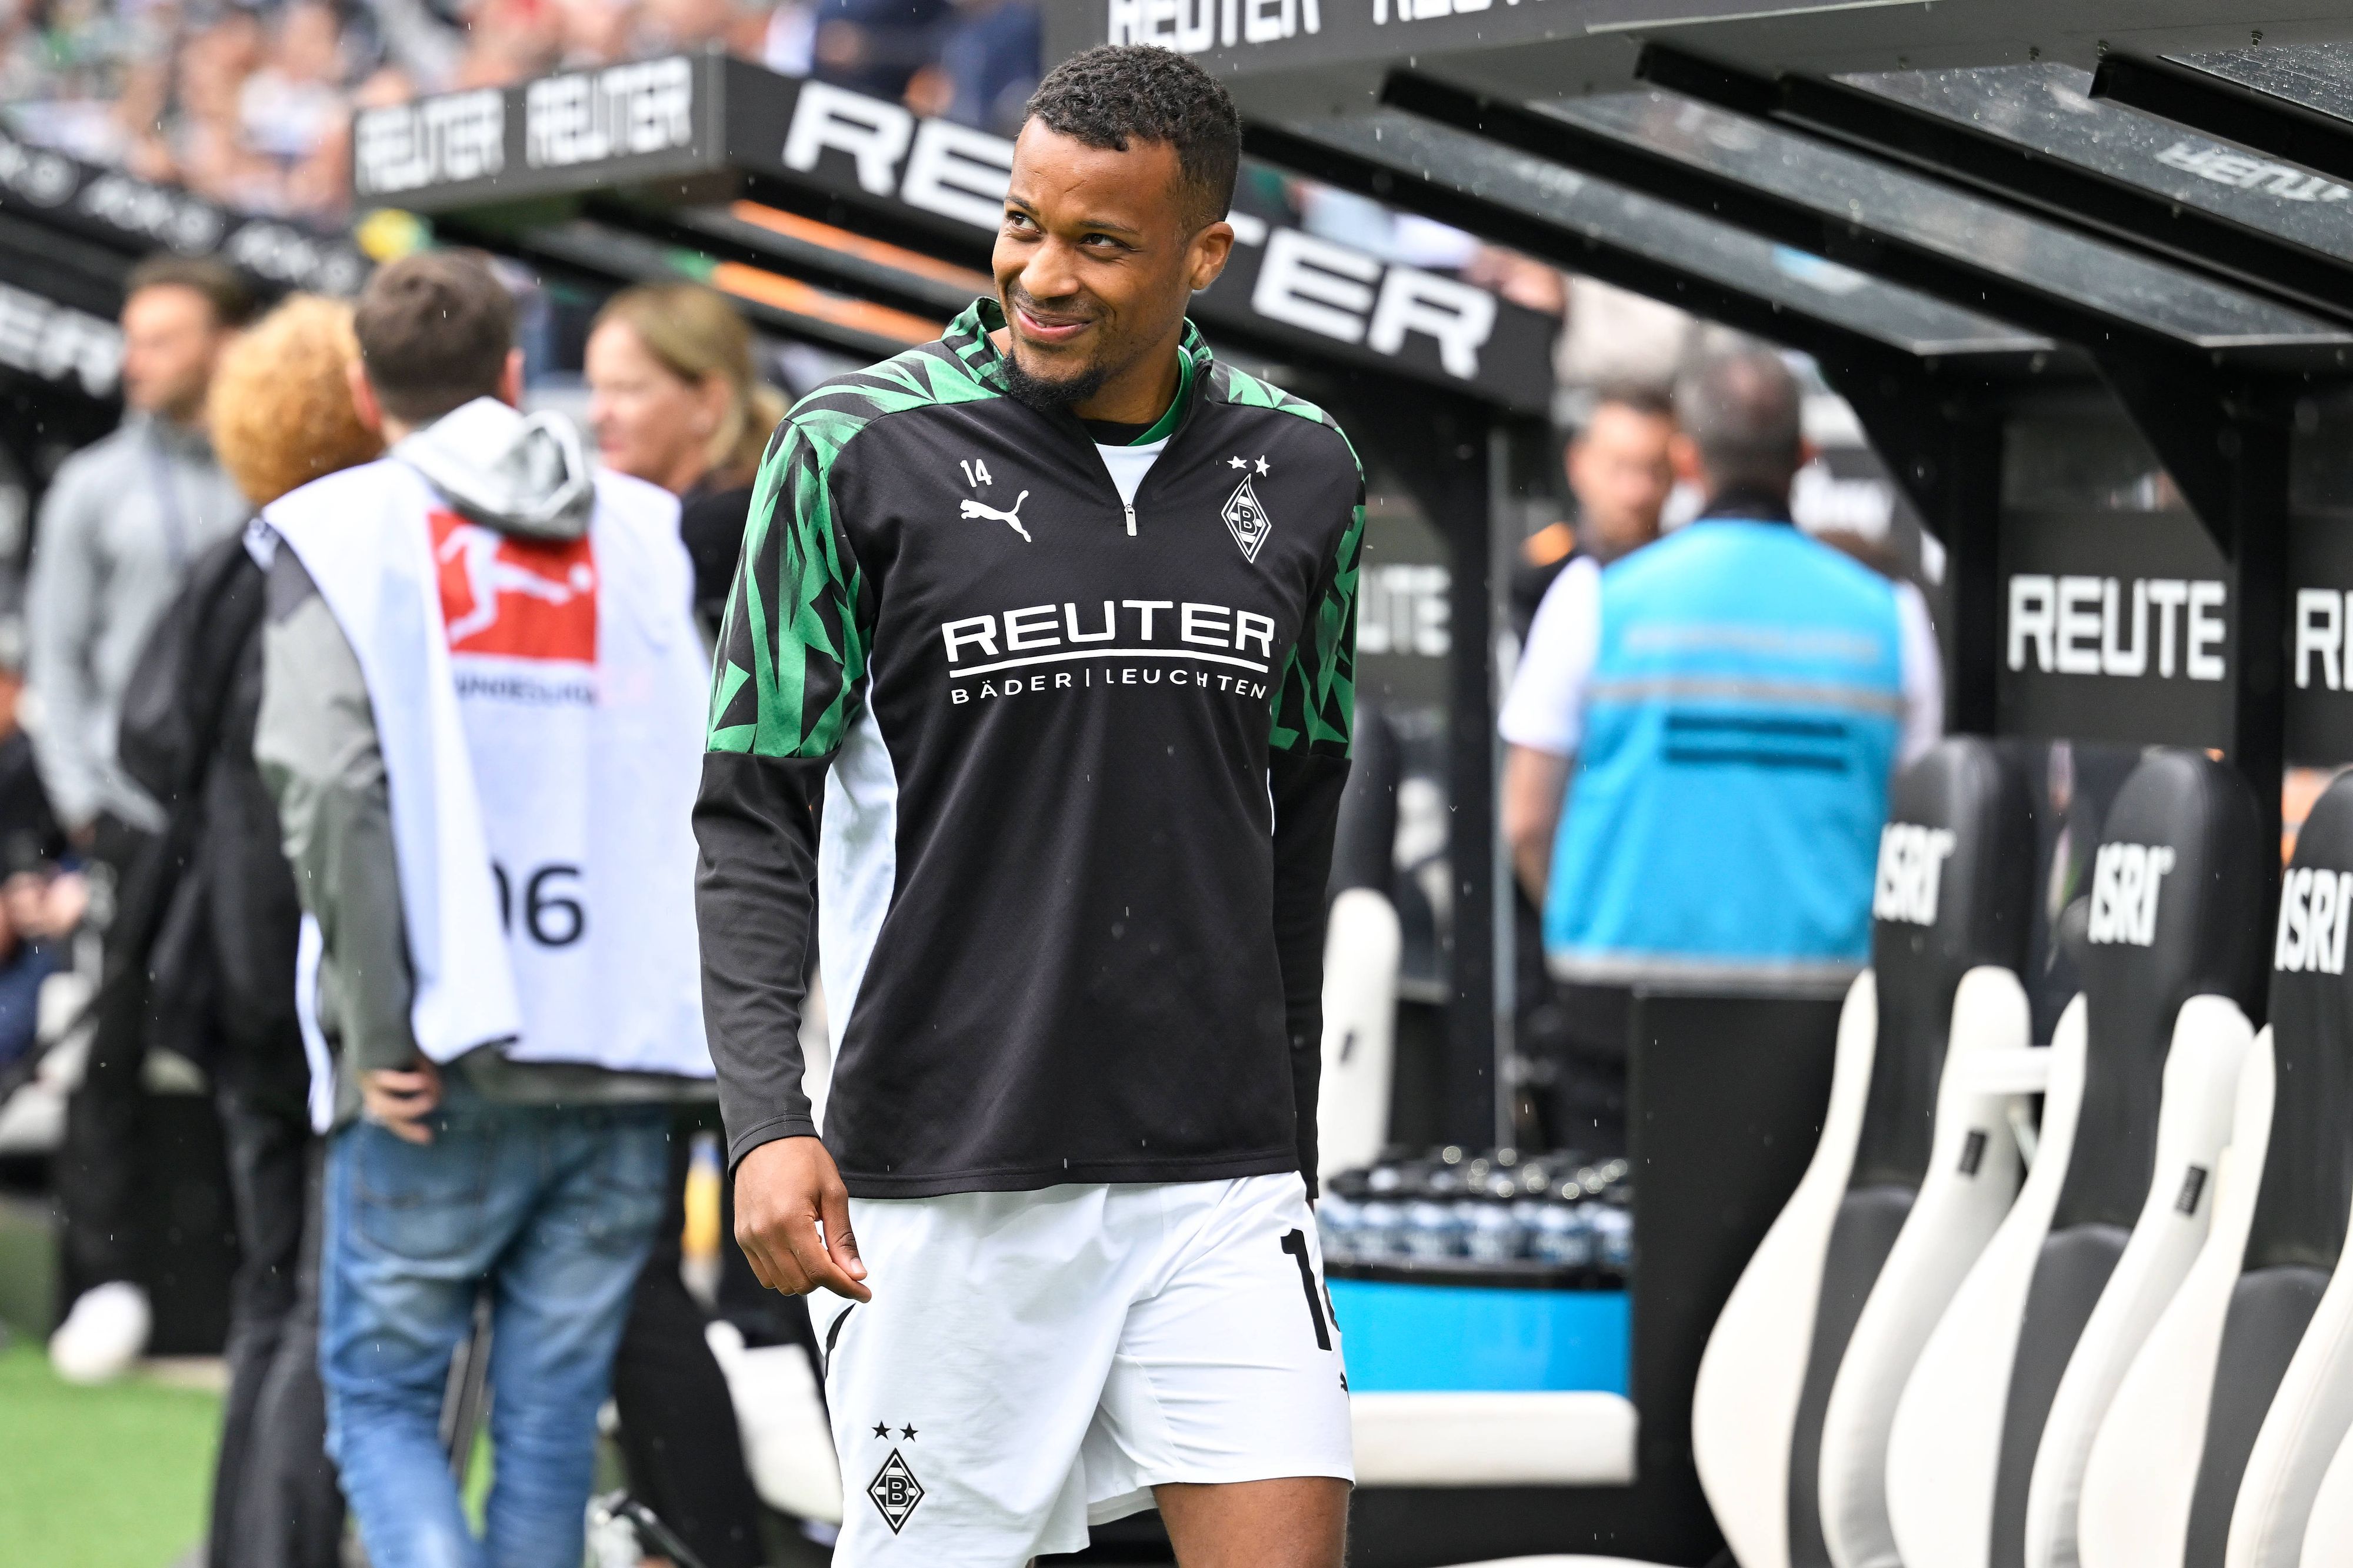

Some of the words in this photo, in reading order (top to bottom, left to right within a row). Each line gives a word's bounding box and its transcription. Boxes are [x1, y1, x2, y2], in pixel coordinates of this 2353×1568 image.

[960, 459, 993, 488] 14
[942, 600, 1275, 662] REUTER
[951, 672, 1072, 705] BÄDER
[1106, 668, 1267, 699] LEUCHTEN
